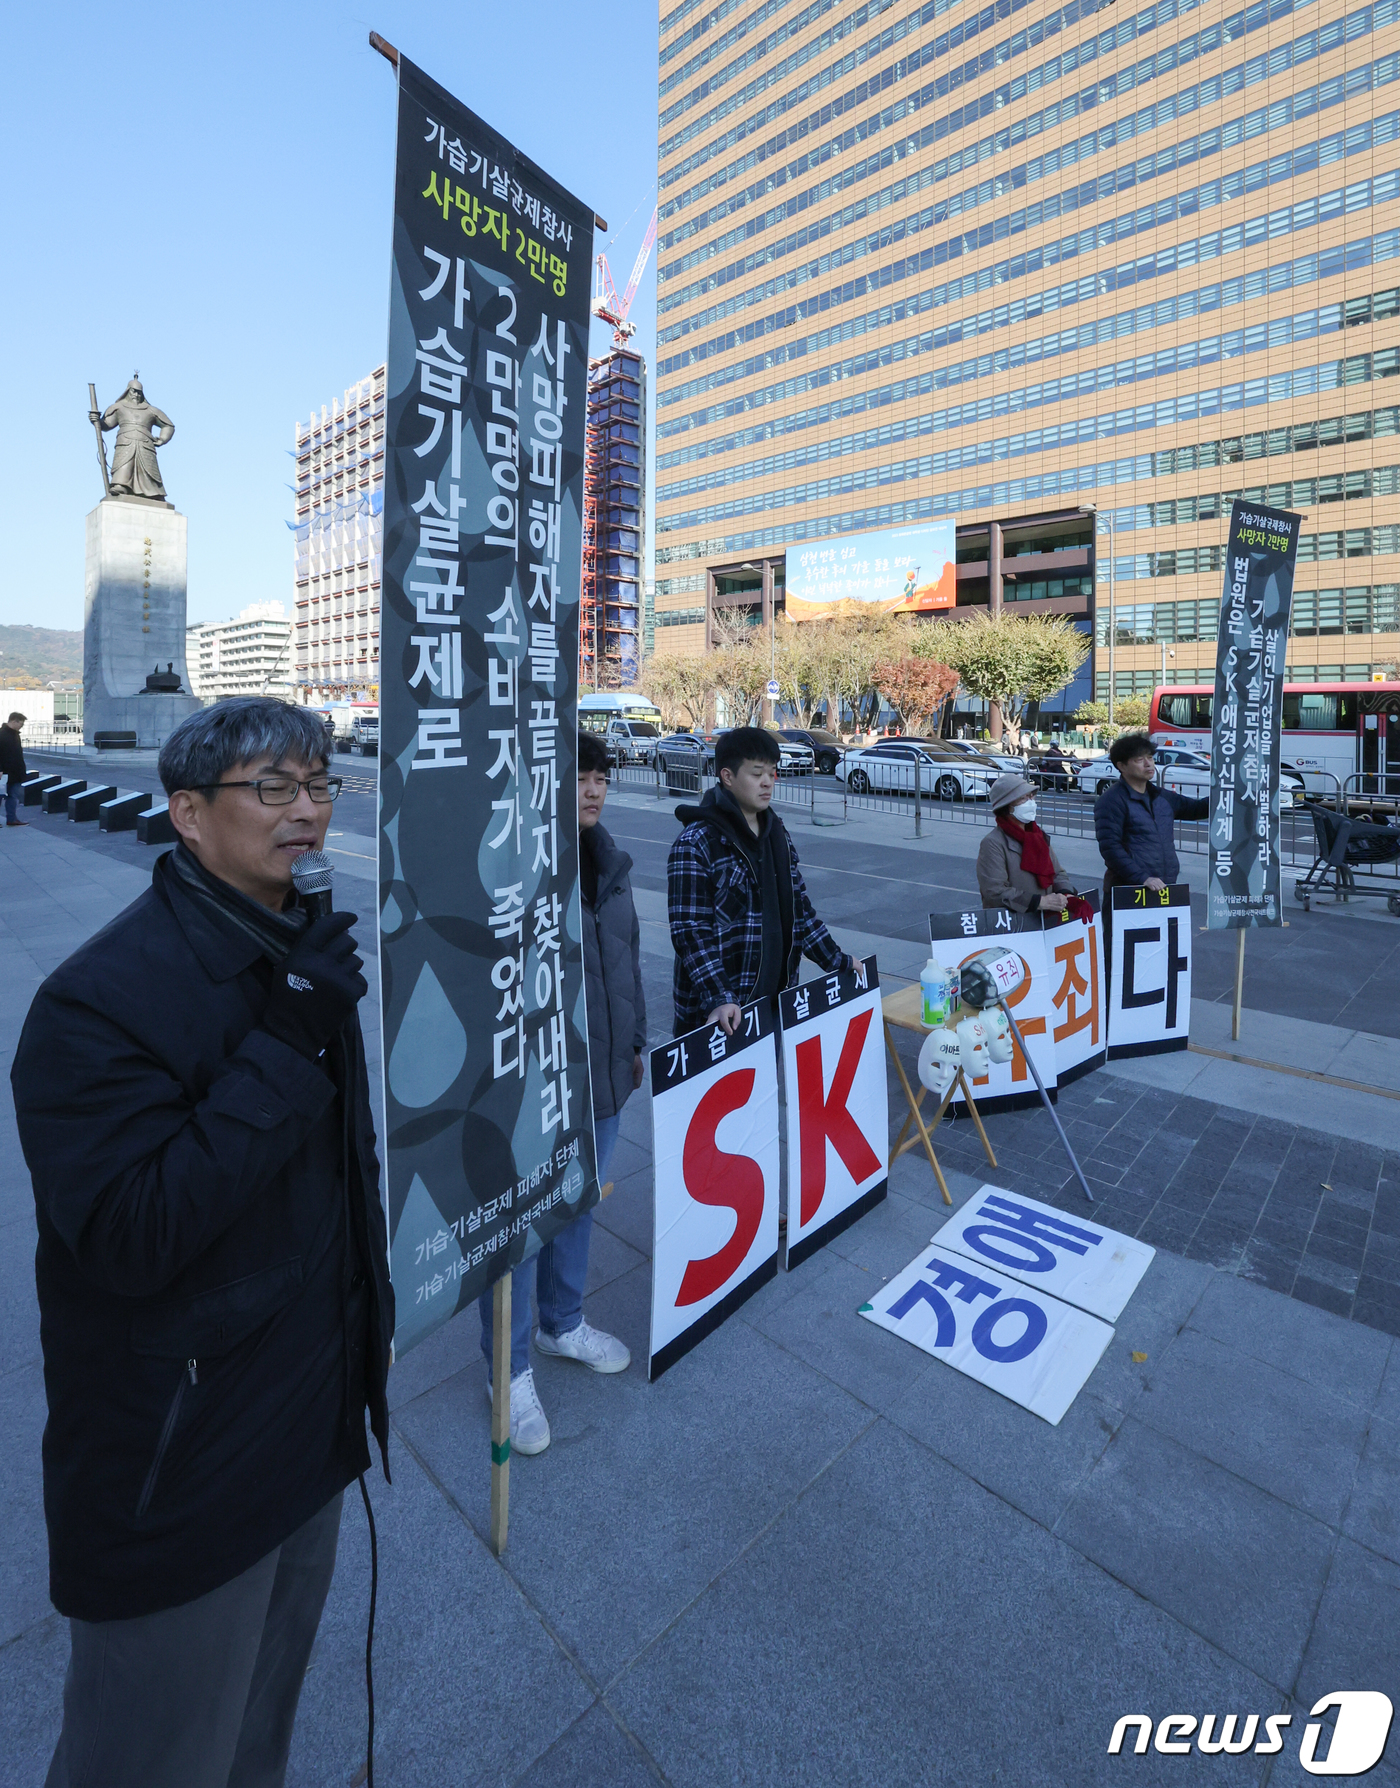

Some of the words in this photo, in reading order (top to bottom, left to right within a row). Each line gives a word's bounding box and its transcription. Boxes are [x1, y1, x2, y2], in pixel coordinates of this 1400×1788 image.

[422, 170, 511, 252] 사망자
[515, 227, 568, 297] 2만명
[424, 116, 573, 252] 가습기살균제참사
[484, 286, 523, 562] 2만명의
[408, 245, 471, 770] 가습기살균제로
[527, 312, 571, 682] 사망피해자를
[840, 546, 856, 560] 심고
[1236, 528, 1267, 547] 사망자
[1267, 533, 1289, 553] 2만명
[1238, 511, 1292, 534] 가습기살균제참사
[851, 560, 871, 575] 가을
[1227, 556, 1249, 635] 법원은
[484, 586, 524, 855] 소비자가
[1260, 628, 1279, 756] 살인기업을
[528, 700, 561, 877] 끝까지
[960, 910, 1013, 935] 참사
[1134, 888, 1170, 906] 기업
[1215, 851, 1234, 877] 등
[488, 880, 528, 1080] 죽었다
[533, 892, 573, 1136] 찾아내라
[793, 963, 869, 1021] 살균제
[996, 957, 1020, 987] 유죄
[1052, 925, 1099, 1047] 죄
[1121, 917, 1188, 1030] 다
[667, 1006, 762, 1078] 가습기
[414, 1187, 513, 1266] 가습기살균제
[516, 1157, 554, 1199] 피해자
[555, 1137, 580, 1170] 단체
[415, 1172, 582, 1305] 가습기살균제참사전국네트워크
